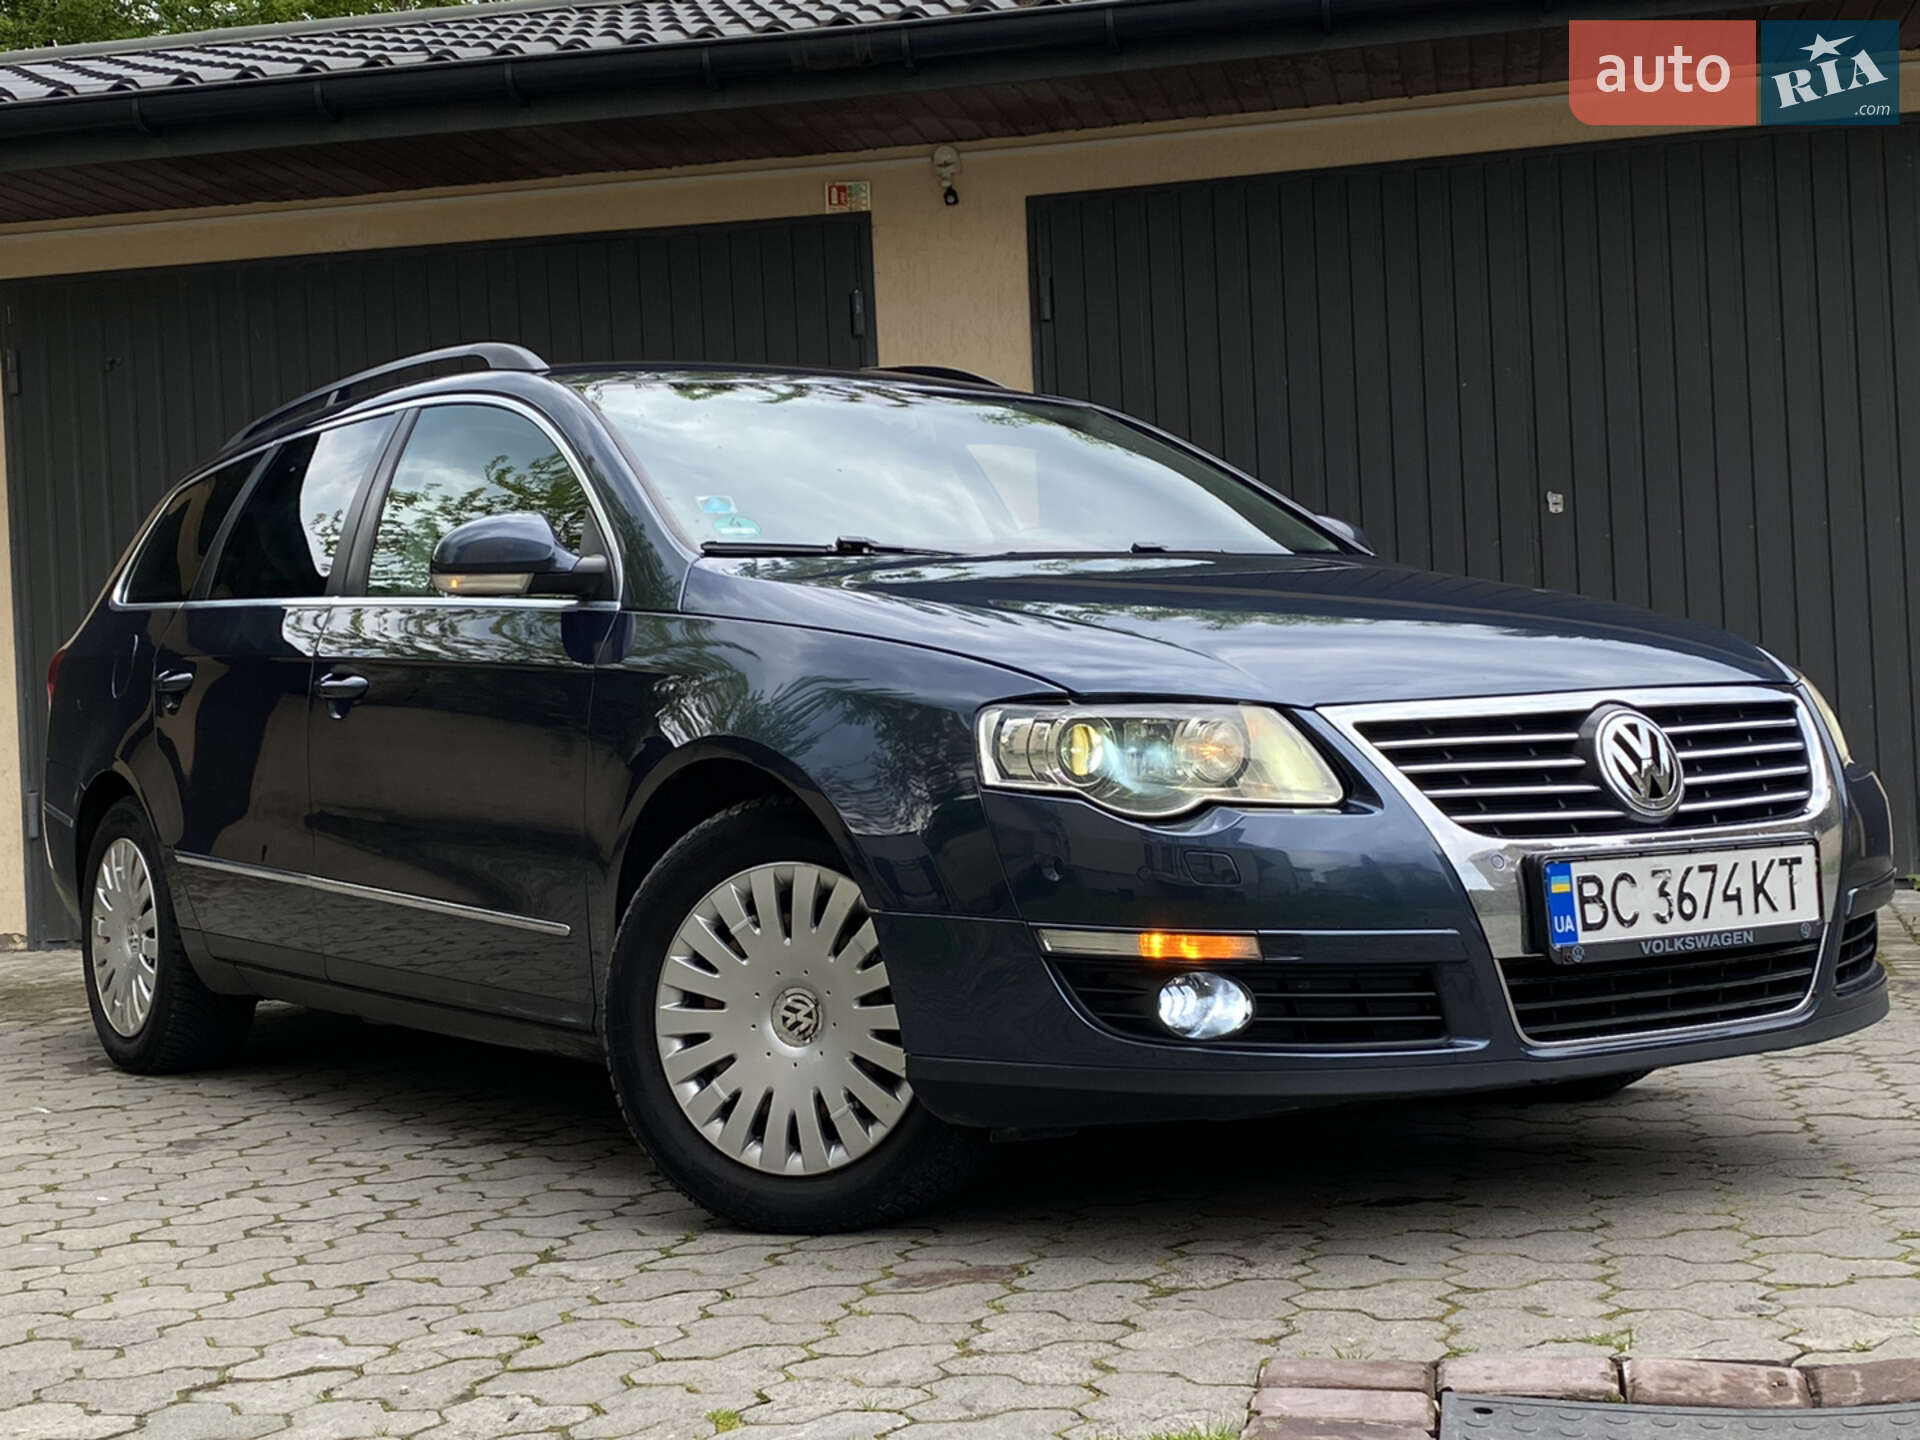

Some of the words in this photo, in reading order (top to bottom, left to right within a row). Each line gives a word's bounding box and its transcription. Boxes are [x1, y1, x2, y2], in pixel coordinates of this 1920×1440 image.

[1577, 872, 1639, 931] BC
[1651, 862, 1743, 924] 3674
[1752, 857, 1802, 914] KT
[1555, 915, 1575, 933] UA
[1640, 929, 1755, 955] VOLKSWAGEN
